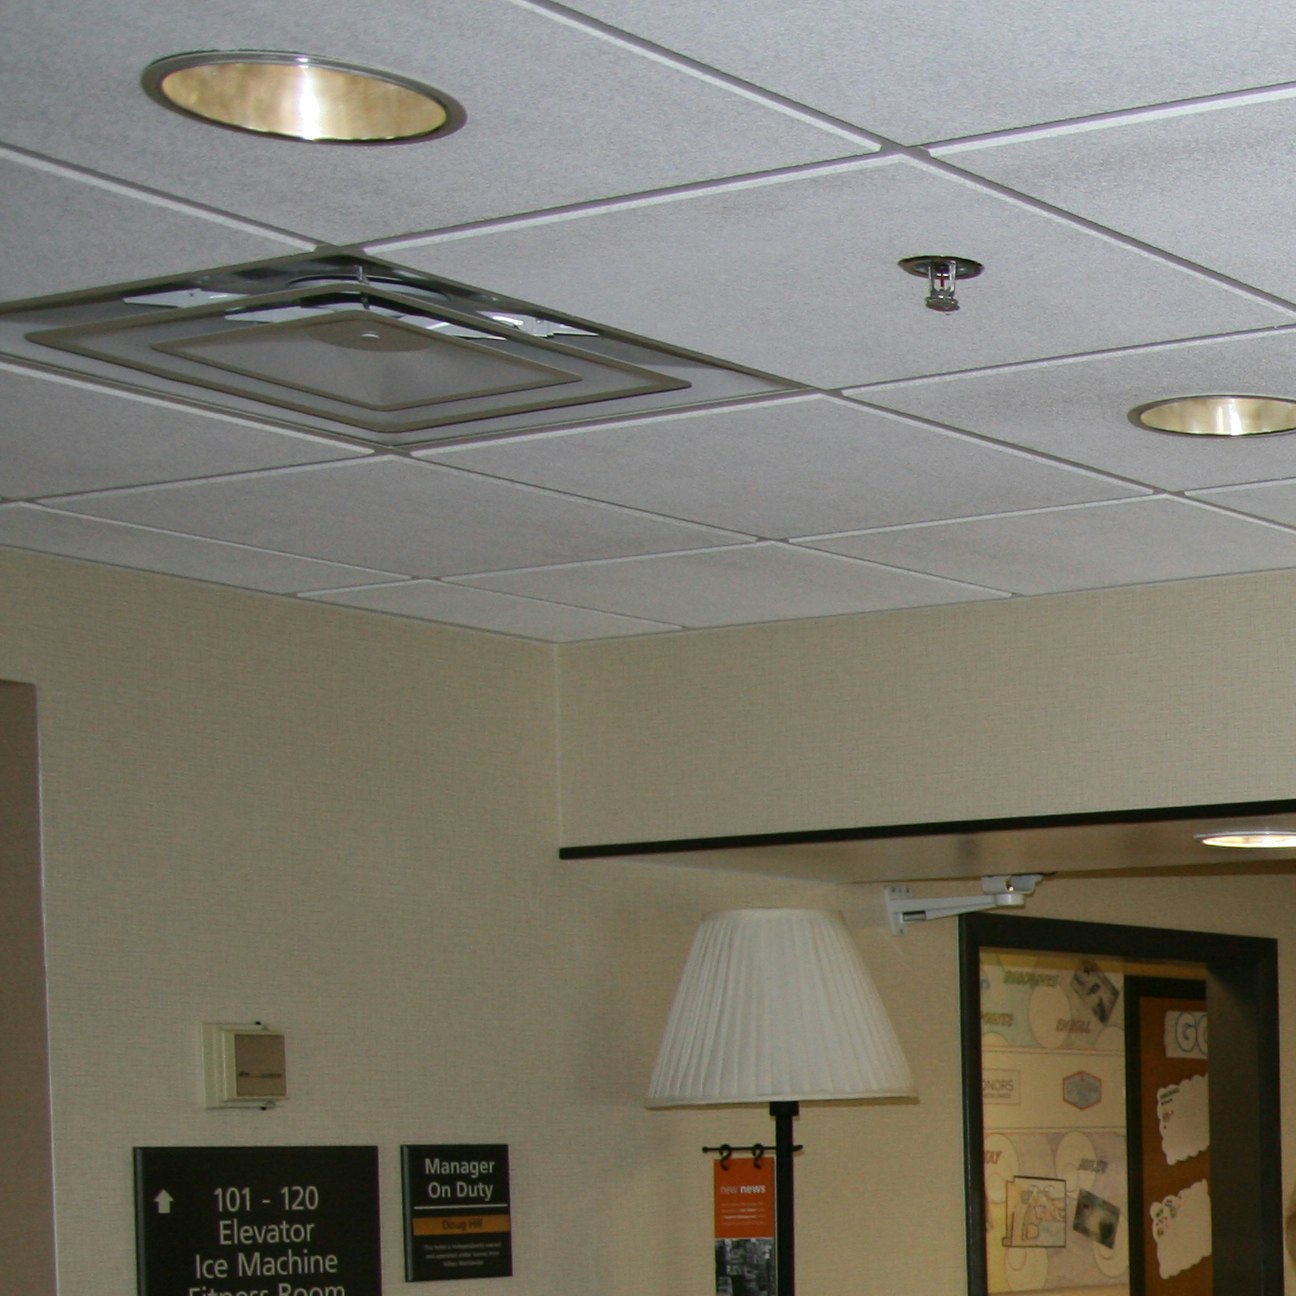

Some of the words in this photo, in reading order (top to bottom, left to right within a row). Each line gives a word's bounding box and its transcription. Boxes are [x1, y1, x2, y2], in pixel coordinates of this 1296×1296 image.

[424, 1157, 495, 1179] Manager
[214, 1186, 251, 1212] 101
[281, 1186, 319, 1211] 120
[428, 1181, 451, 1199] On
[456, 1180, 494, 1202] Duty
[740, 1184, 766, 1194] news
[219, 1219, 315, 1246] Elevator
[442, 1219, 467, 1232] Doug
[195, 1254, 229, 1279] Ice
[238, 1249, 338, 1277] Machine
